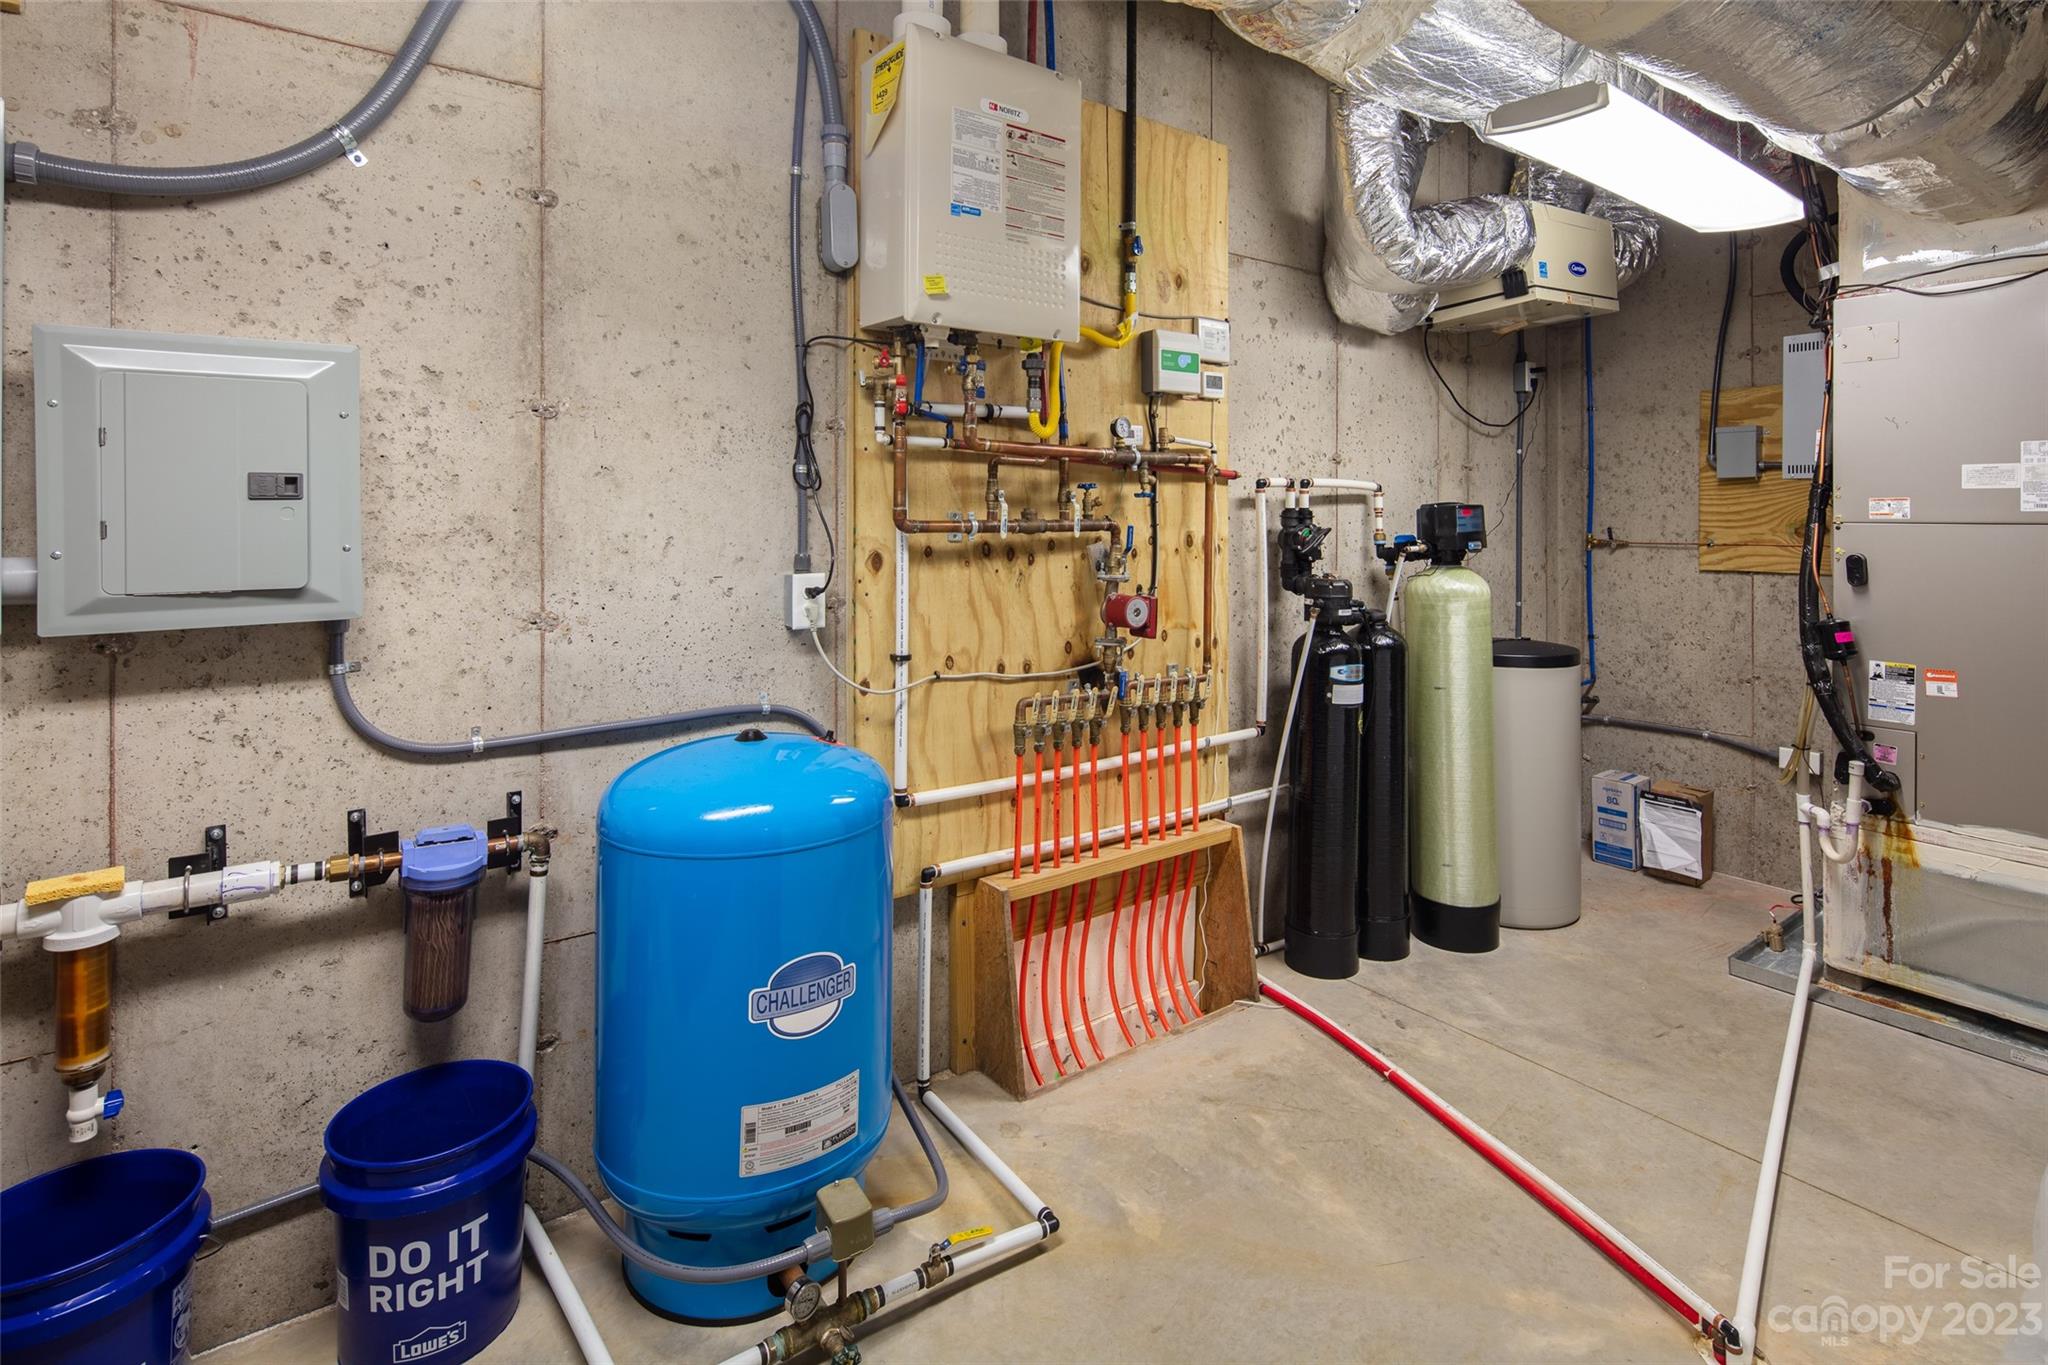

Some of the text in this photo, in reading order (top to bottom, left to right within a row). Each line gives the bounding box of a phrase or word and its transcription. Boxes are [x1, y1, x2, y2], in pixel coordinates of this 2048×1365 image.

[999, 104, 1021, 117] NORITZ
[756, 971, 851, 1014] CHALLENGER
[368, 1212, 489, 1279] DO IT
[369, 1249, 489, 1313] RIGHT
[400, 1328, 460, 1360] LOWE'S
